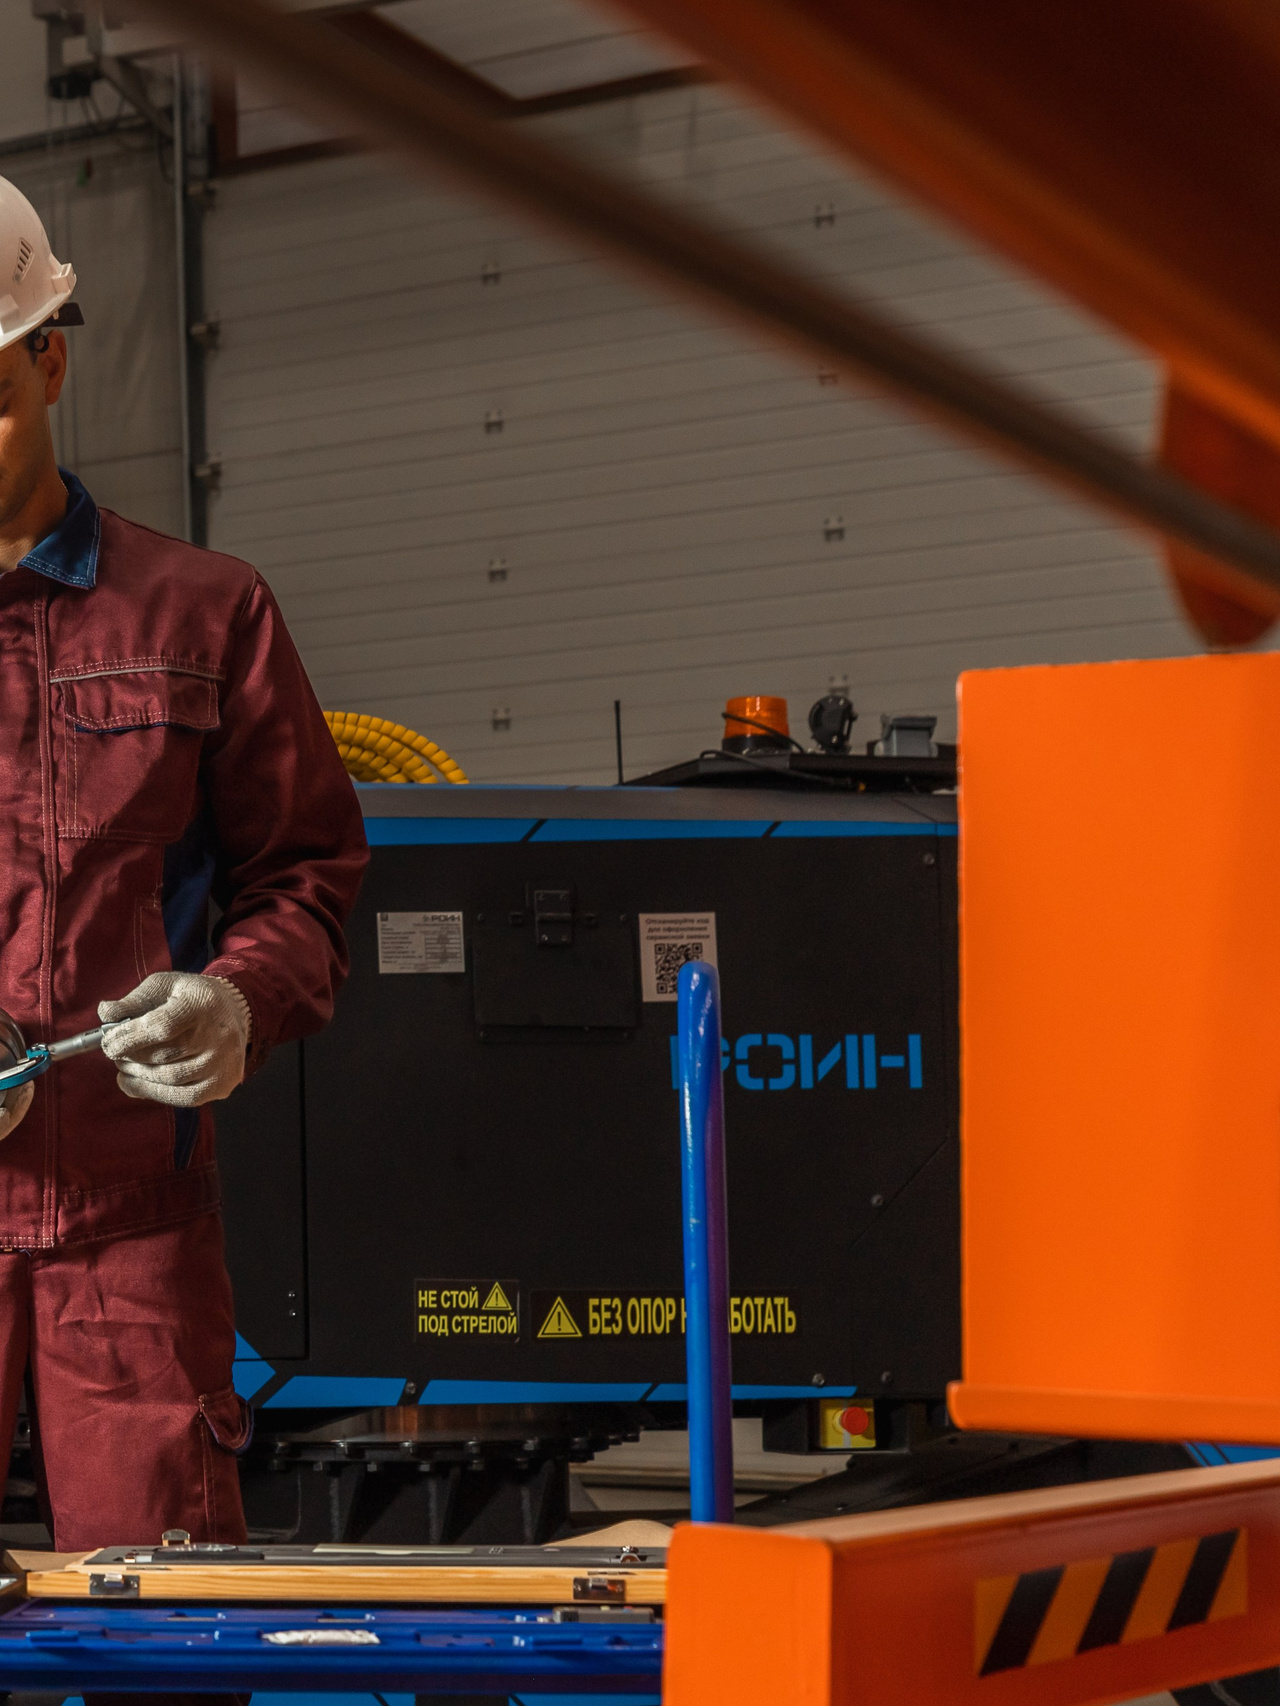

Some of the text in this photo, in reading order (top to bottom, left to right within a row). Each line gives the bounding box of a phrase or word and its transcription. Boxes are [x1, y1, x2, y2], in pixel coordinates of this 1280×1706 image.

[418, 1286, 479, 1309] НЕ СТОЙ
[418, 1311, 518, 1336] ПОД СТРЕЛОЙ
[588, 1297, 623, 1334] БЕЗ
[627, 1297, 677, 1334] ОПОР
[728, 1296, 797, 1334] БОТАТЬ
